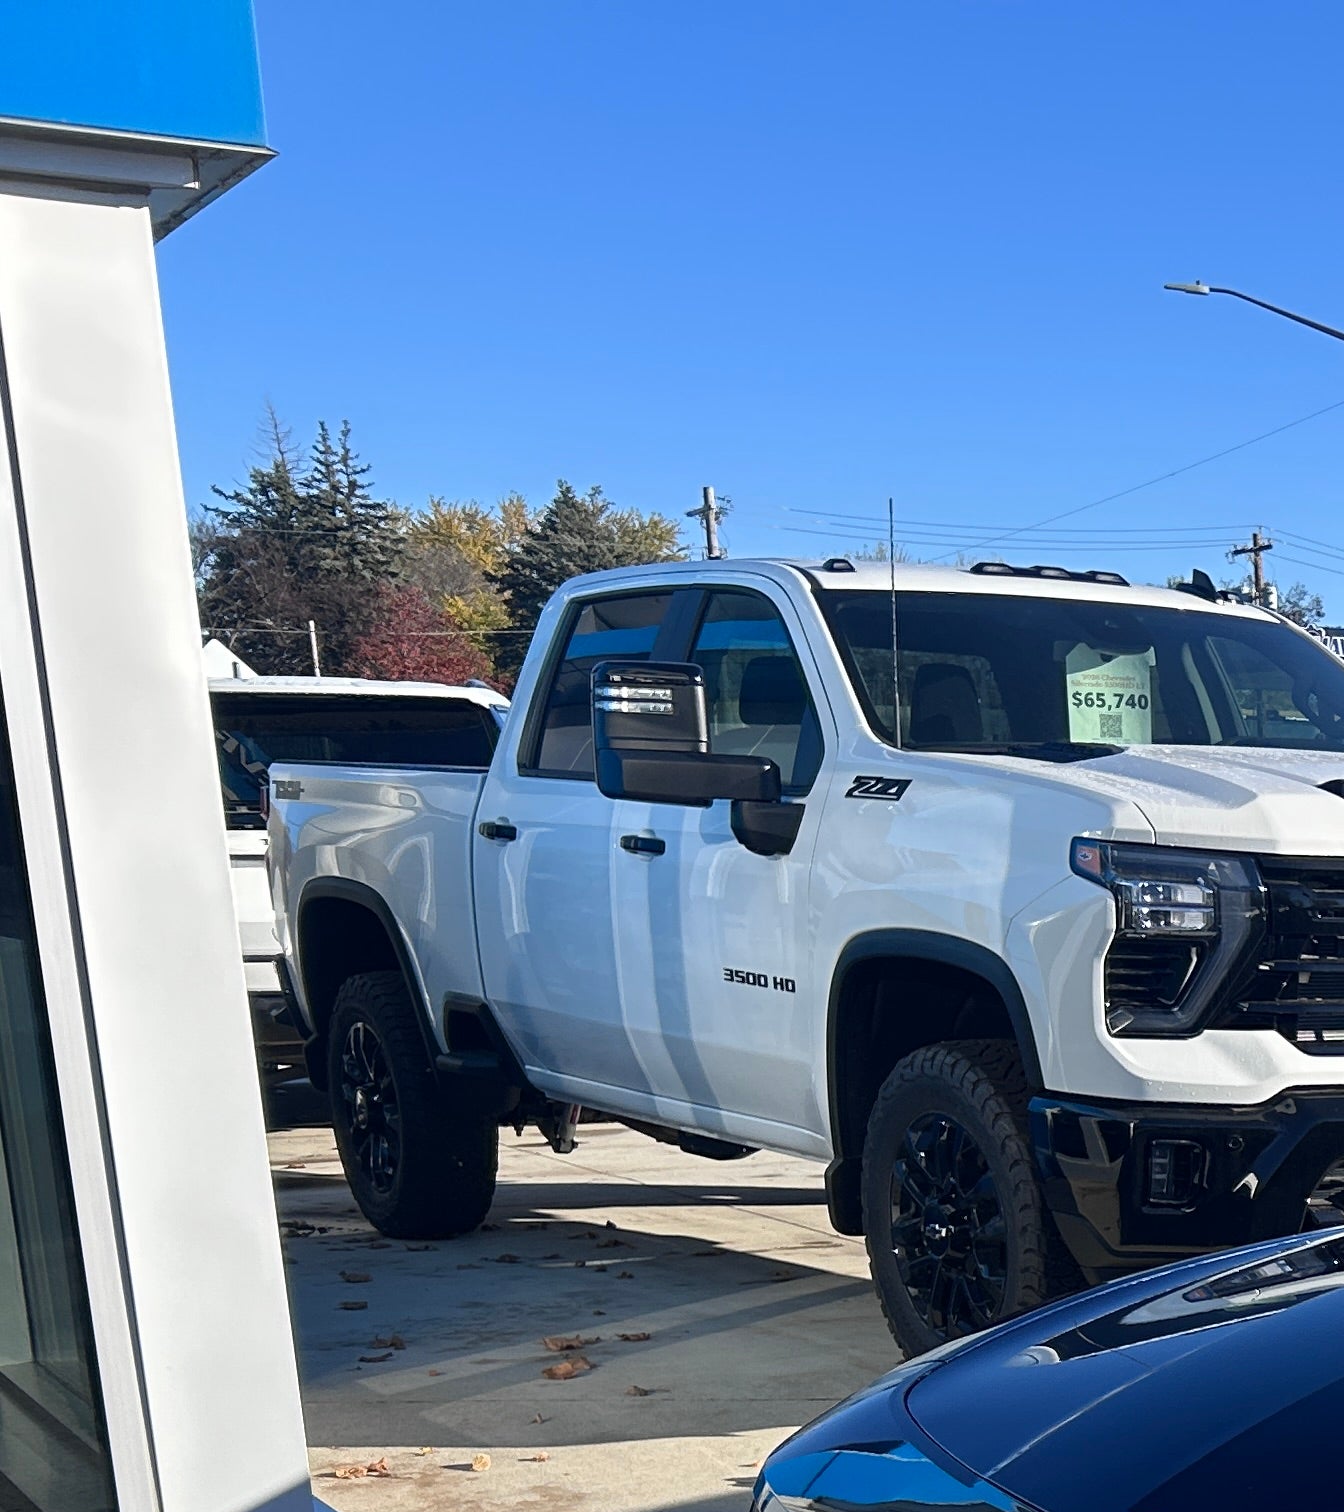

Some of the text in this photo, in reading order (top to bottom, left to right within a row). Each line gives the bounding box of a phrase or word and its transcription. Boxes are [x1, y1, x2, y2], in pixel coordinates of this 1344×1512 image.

[1071, 690, 1149, 712] $65,740
[723, 967, 796, 994] 3500 HD
